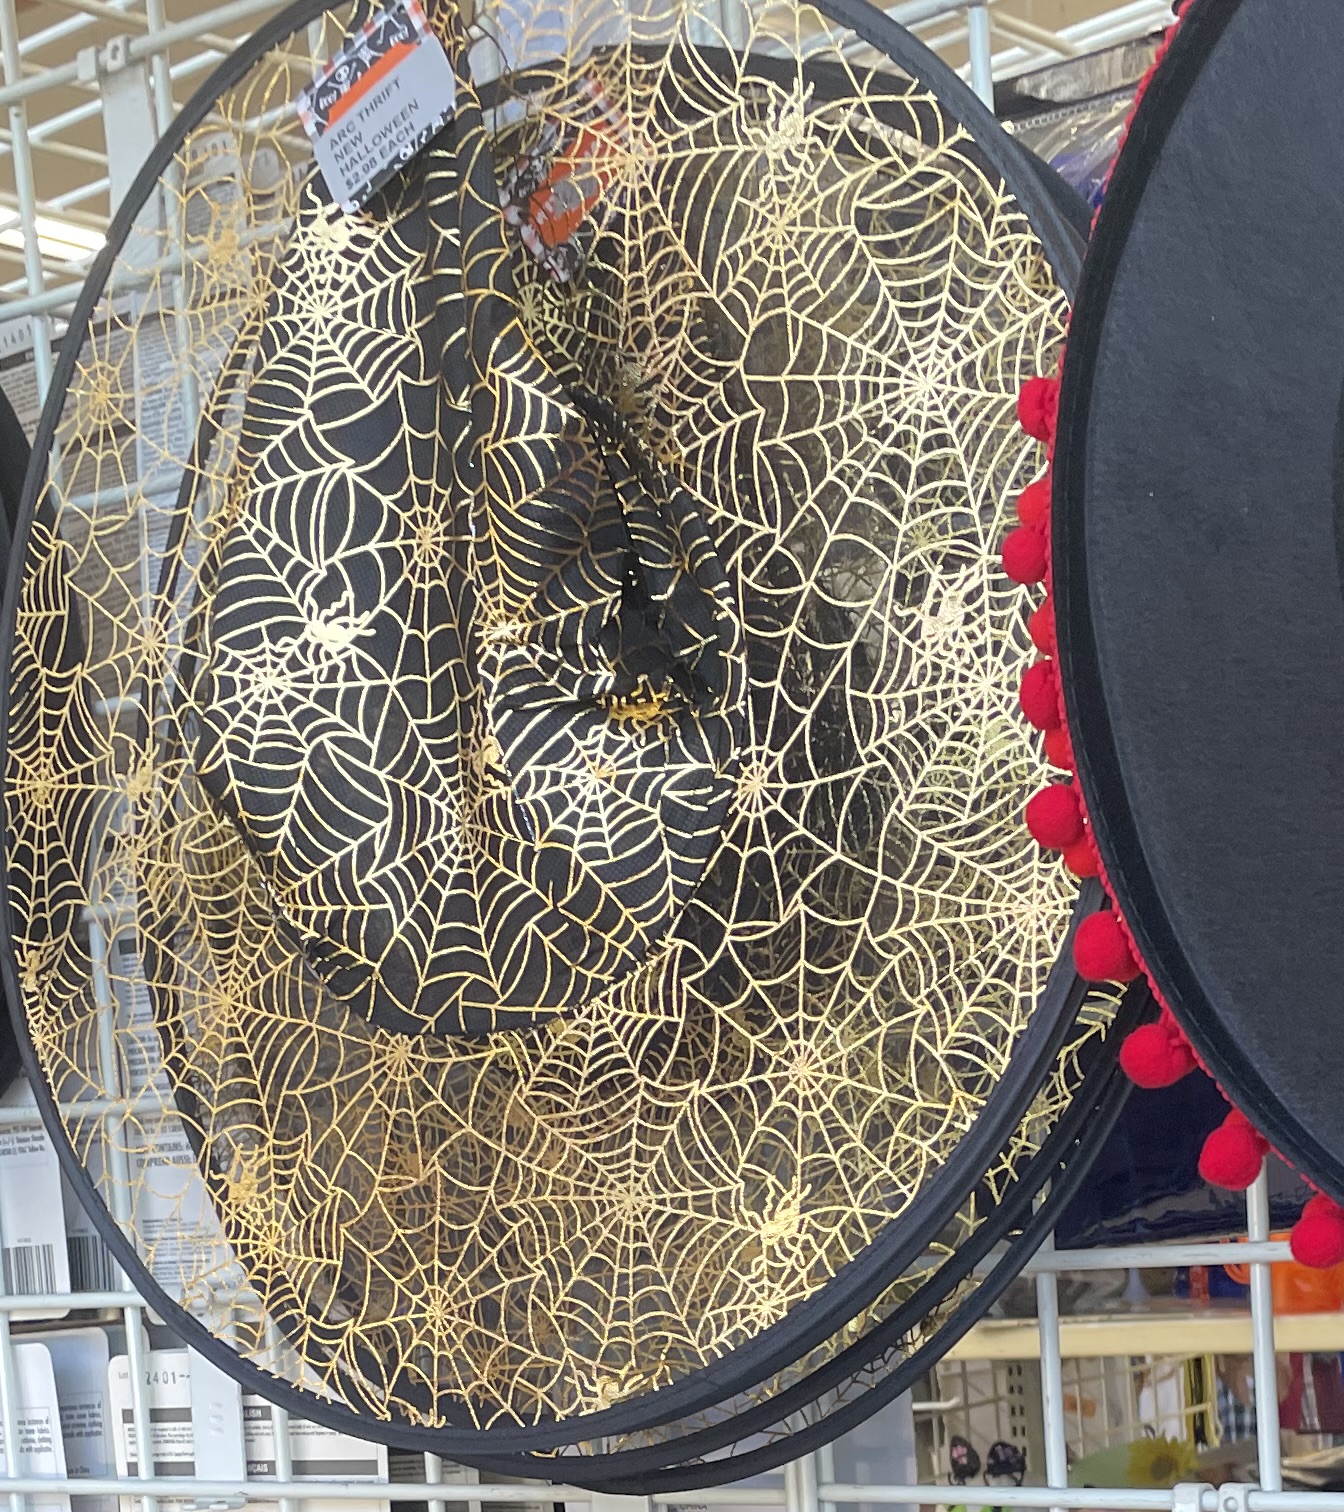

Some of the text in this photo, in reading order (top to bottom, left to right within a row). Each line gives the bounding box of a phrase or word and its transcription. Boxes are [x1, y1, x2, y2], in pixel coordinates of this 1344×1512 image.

[330, 76, 401, 151] ARC THRIFT
[339, 98, 419, 177] HALLOWEEN
[379, 121, 416, 160] EACH
[334, 131, 363, 164] NEW
